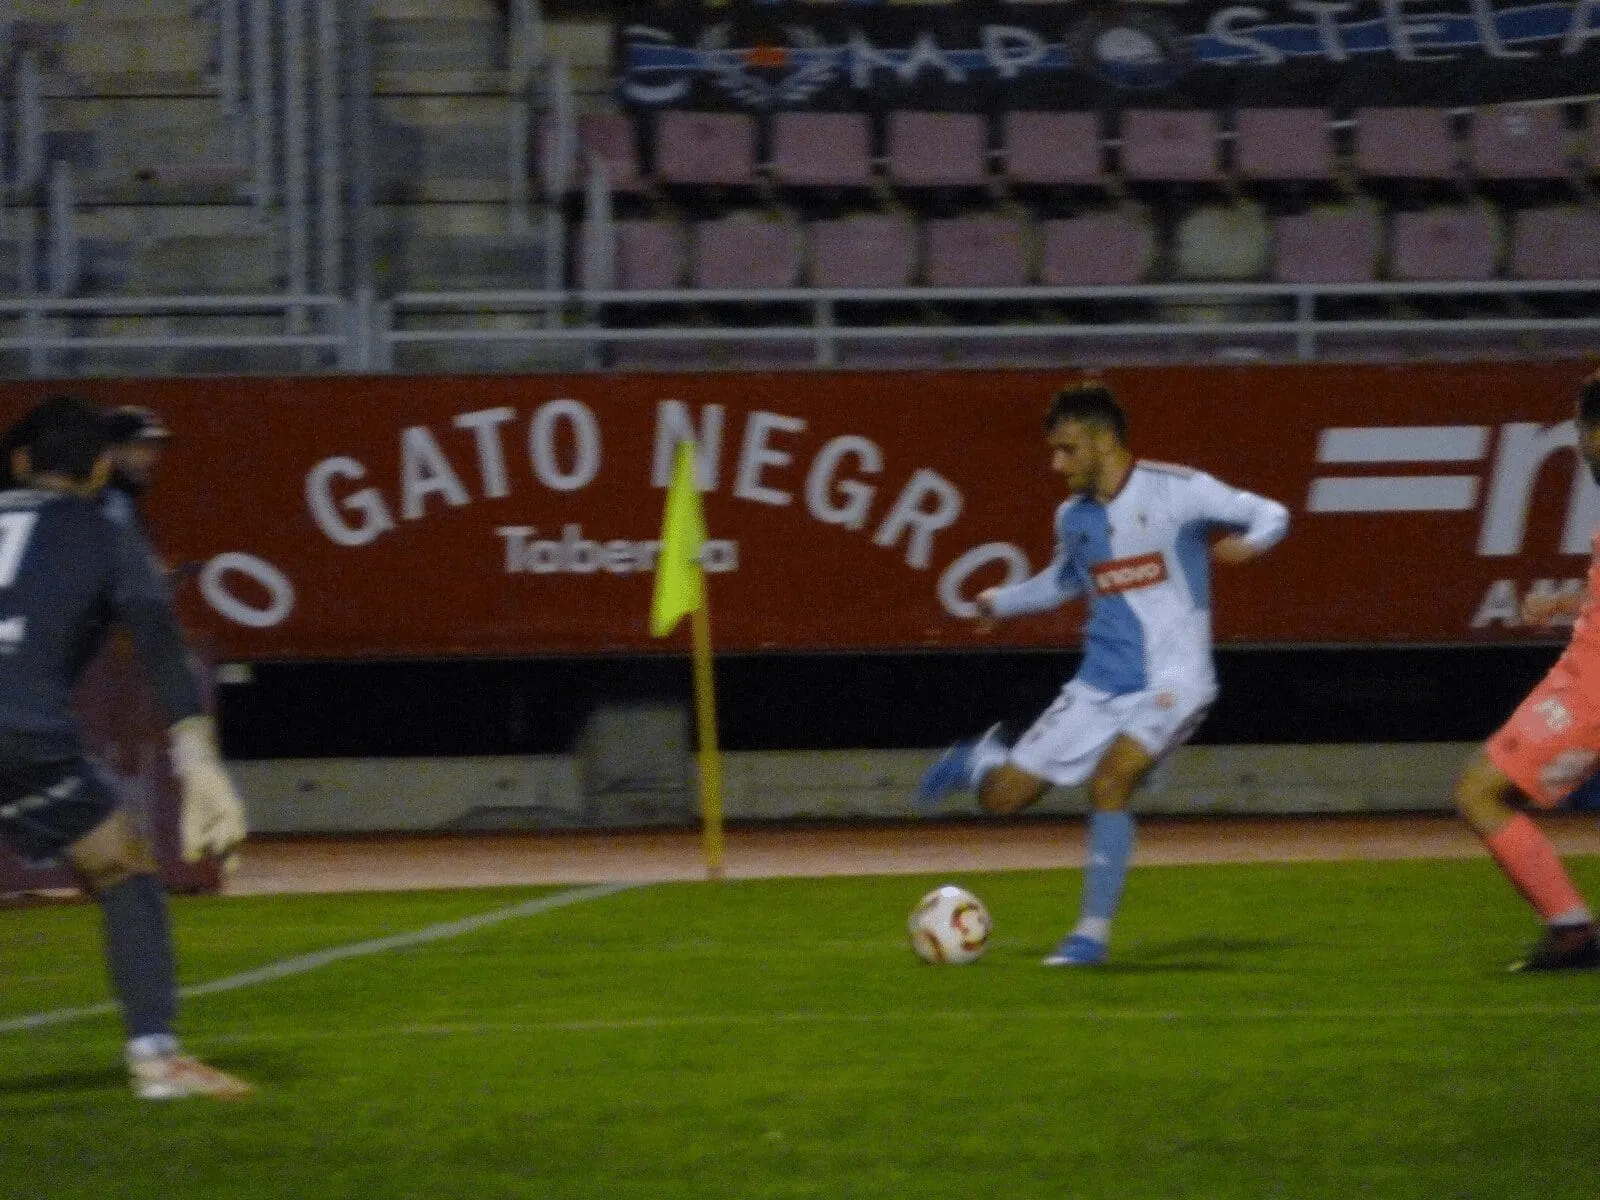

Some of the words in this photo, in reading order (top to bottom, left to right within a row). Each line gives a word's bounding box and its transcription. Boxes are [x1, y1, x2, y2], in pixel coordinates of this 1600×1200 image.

[200, 552, 295, 627] O
[305, 400, 600, 546] GATO
[651, 399, 1032, 619] NEGRO
[496, 523, 738, 572] Tabera
